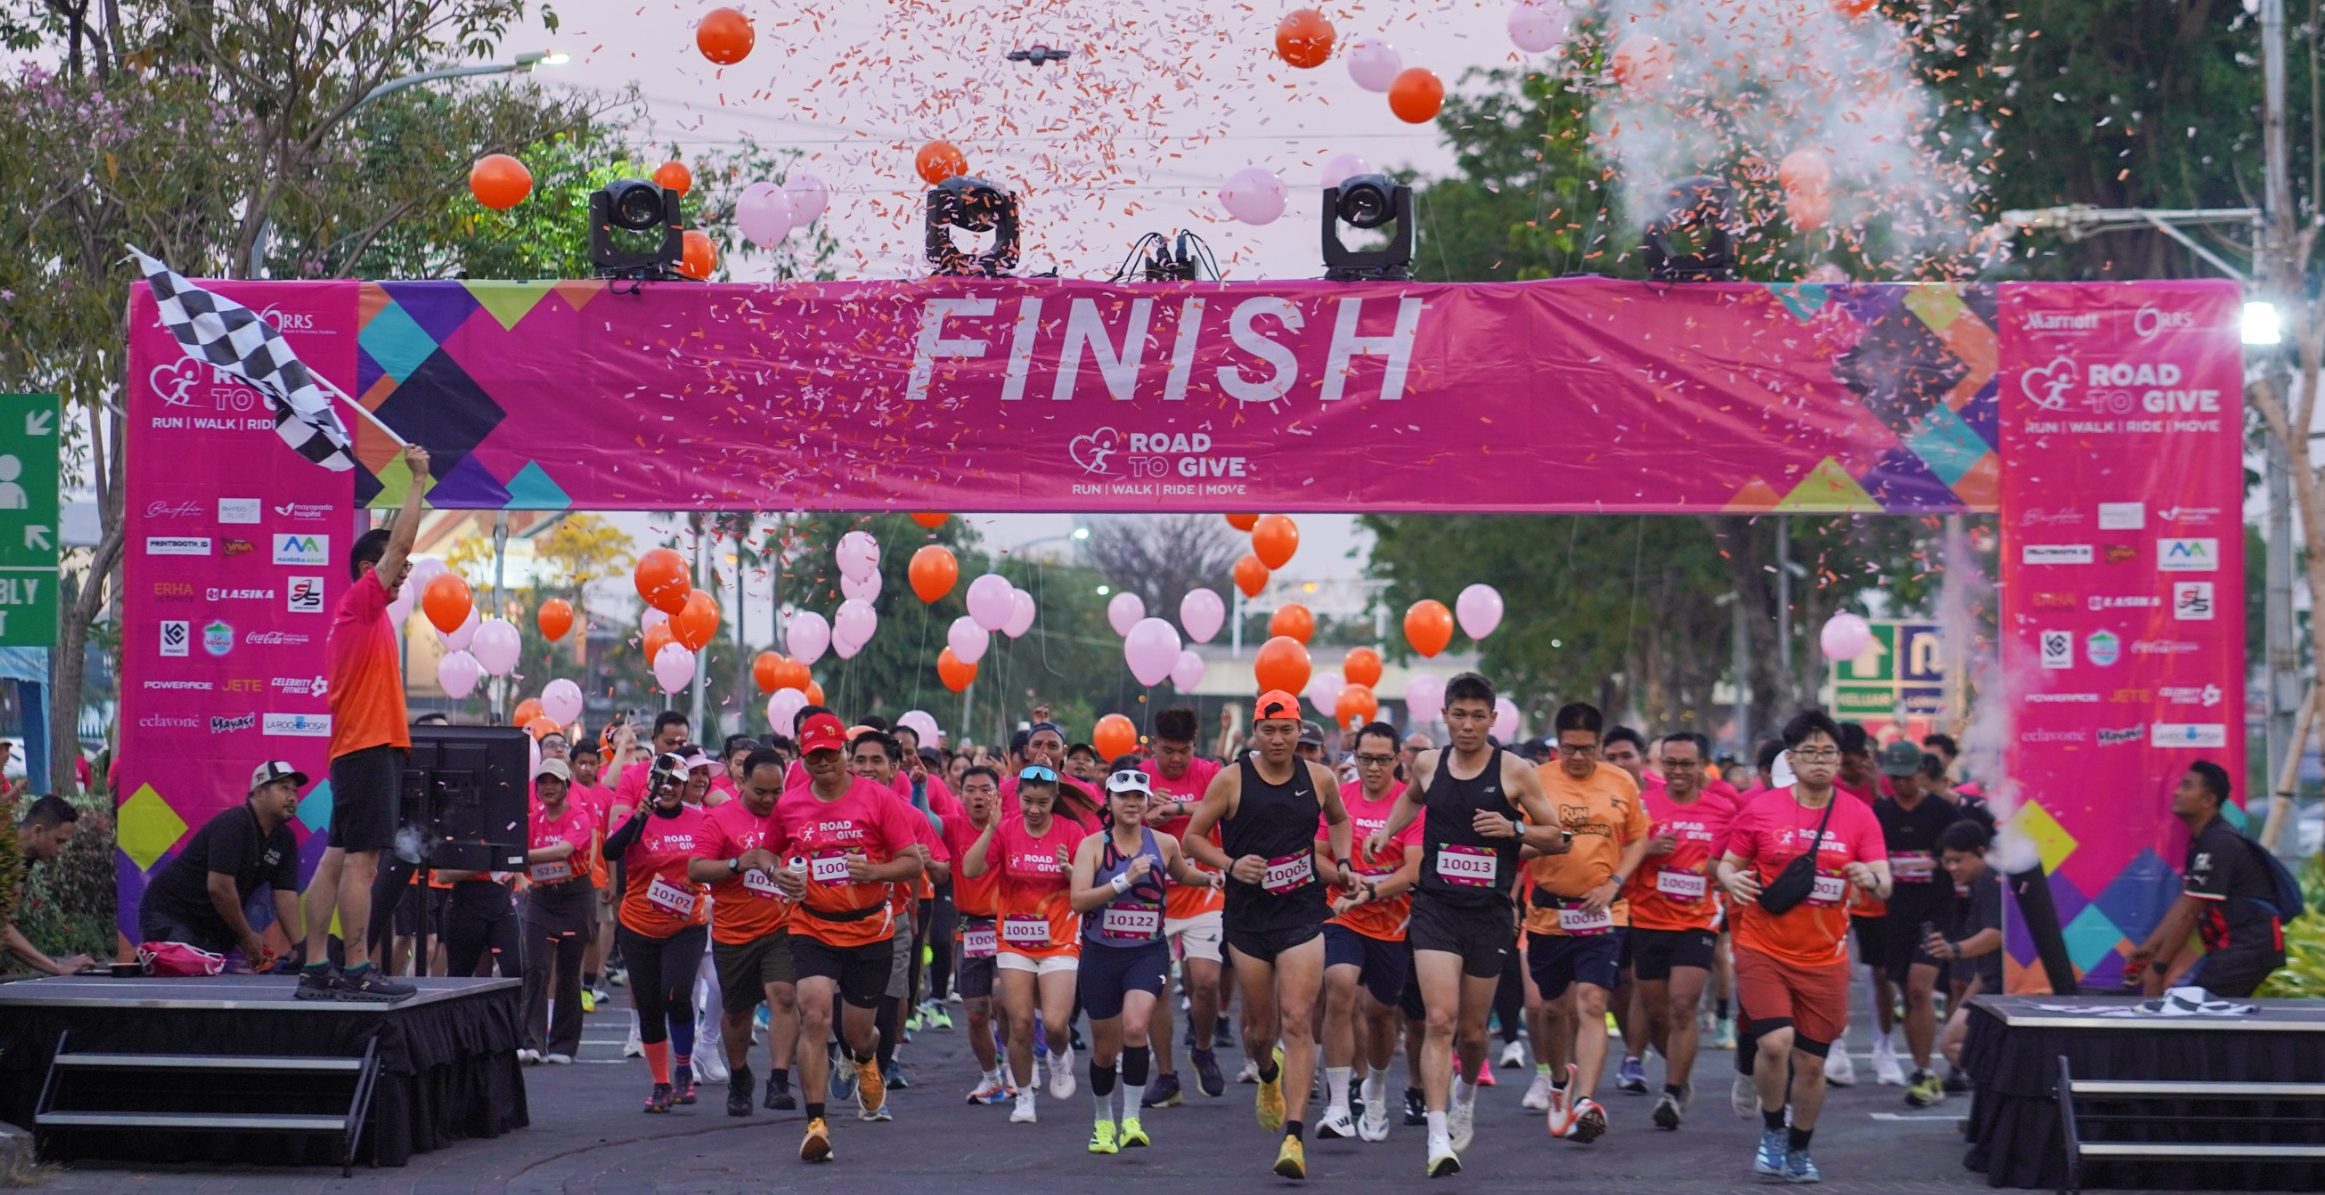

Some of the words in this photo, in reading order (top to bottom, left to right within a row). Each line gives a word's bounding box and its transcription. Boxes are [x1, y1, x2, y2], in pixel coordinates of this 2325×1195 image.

[904, 296, 1424, 402] FINISH
[2088, 363, 2181, 387] ROAD
[211, 388, 254, 411] TO
[2142, 389, 2220, 413] GIVE
[152, 417, 184, 429] RUN
[194, 417, 236, 430] WALK
[2025, 421, 2059, 433] RUN
[2069, 421, 2115, 433] WALK
[2126, 421, 2163, 433] RIDE
[2174, 420, 2221, 433] MOVE
[1130, 432, 1212, 453] ROAD
[1128, 456, 1169, 478] TO
[1178, 456, 1246, 477] GIVE
[1072, 484, 1101, 495] RUN
[1112, 484, 1153, 496] WALK
[1163, 484, 1195, 496] RIDE
[1206, 484, 1246, 496] MOVE
[154, 583, 194, 596] ERHA
[220, 589, 275, 599] LASIKA
[144, 680, 213, 690] POWERADE
[222, 679, 262, 692] JETE
[271, 677, 312, 687] CELEBRITY
[282, 686, 309, 694] FITNESS
[1171, 793, 1195, 802] OAD
[819, 821, 852, 831] ROAD
[1672, 821, 1705, 831] ROAD
[664, 834, 693, 843] ROAD
[836, 829, 863, 839] GIVE
[679, 842, 696, 850] GIV
[1024, 854, 1054, 863] ROAD
[1265, 860, 1308, 883] 10005
[1442, 858, 1492, 873] 10013
[651, 886, 691, 909] 10102
[1107, 914, 1154, 927] 10122
[1006, 925, 1045, 936] 10015
